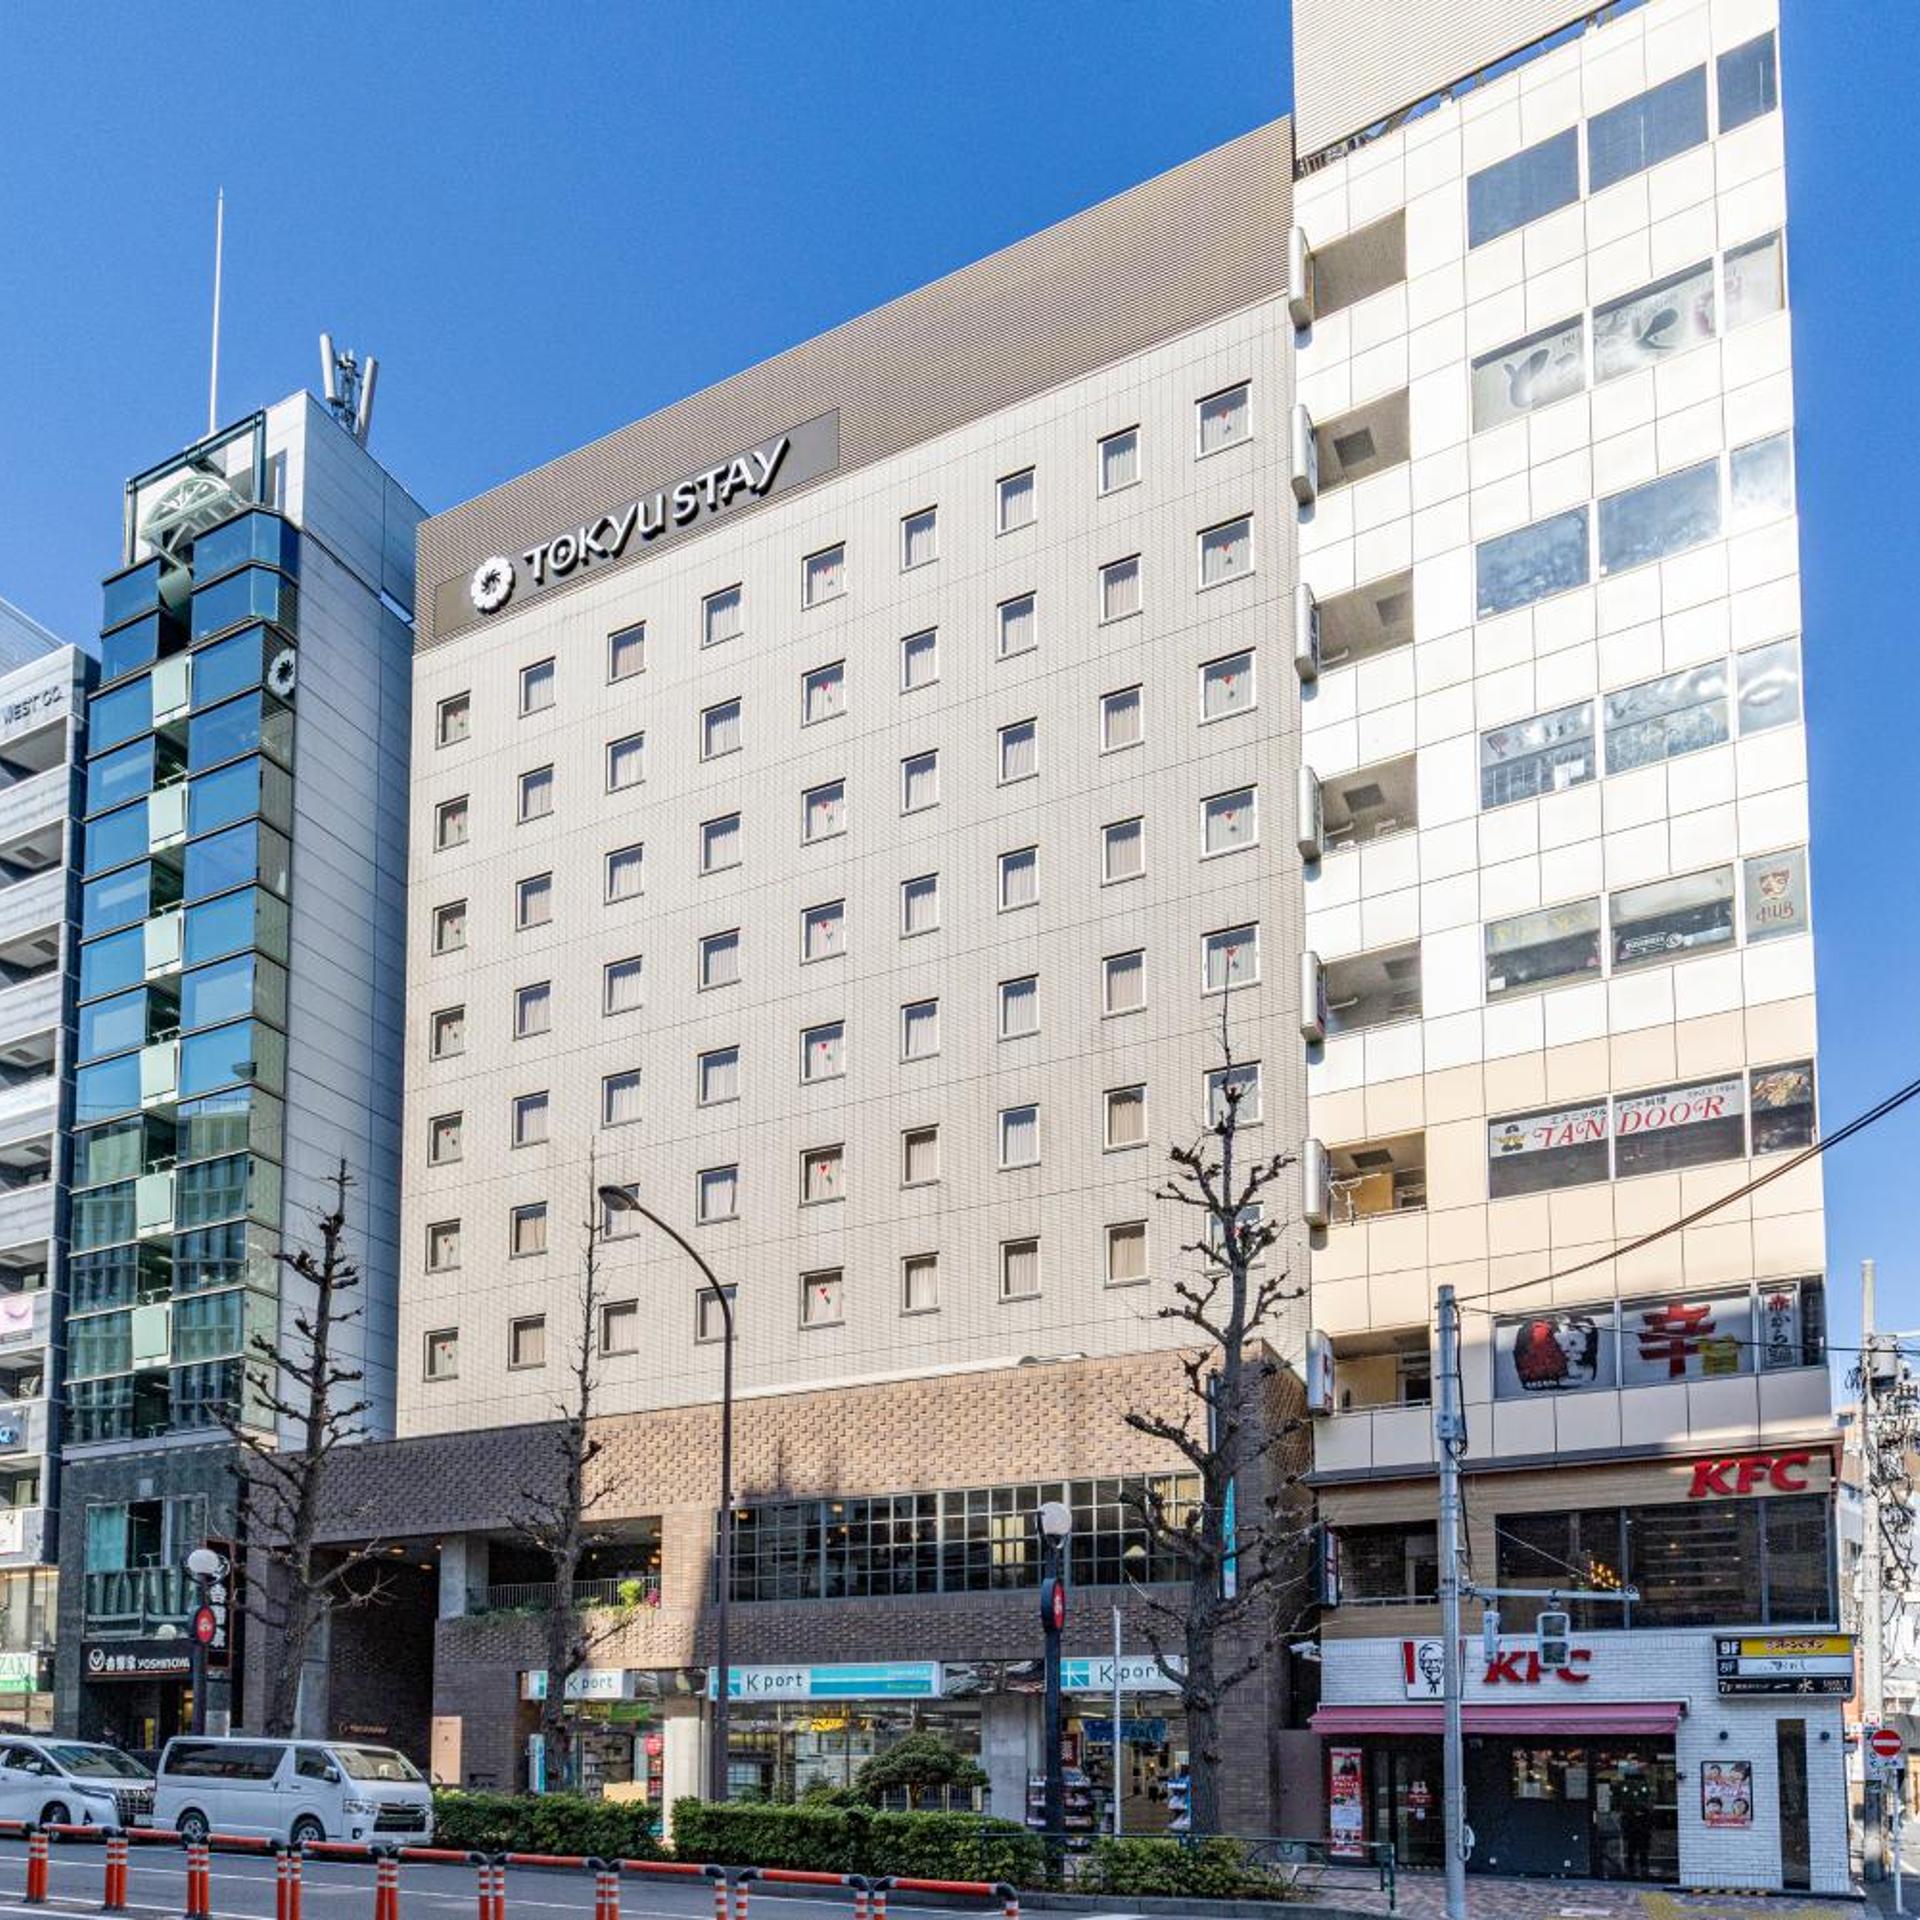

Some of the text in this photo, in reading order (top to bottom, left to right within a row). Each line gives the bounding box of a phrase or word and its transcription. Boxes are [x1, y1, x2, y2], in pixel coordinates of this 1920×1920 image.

[523, 437, 790, 582] TOKYU STAY
[1688, 1453, 1809, 1498] KFC
[1720, 1641, 1739, 1654] 9F
